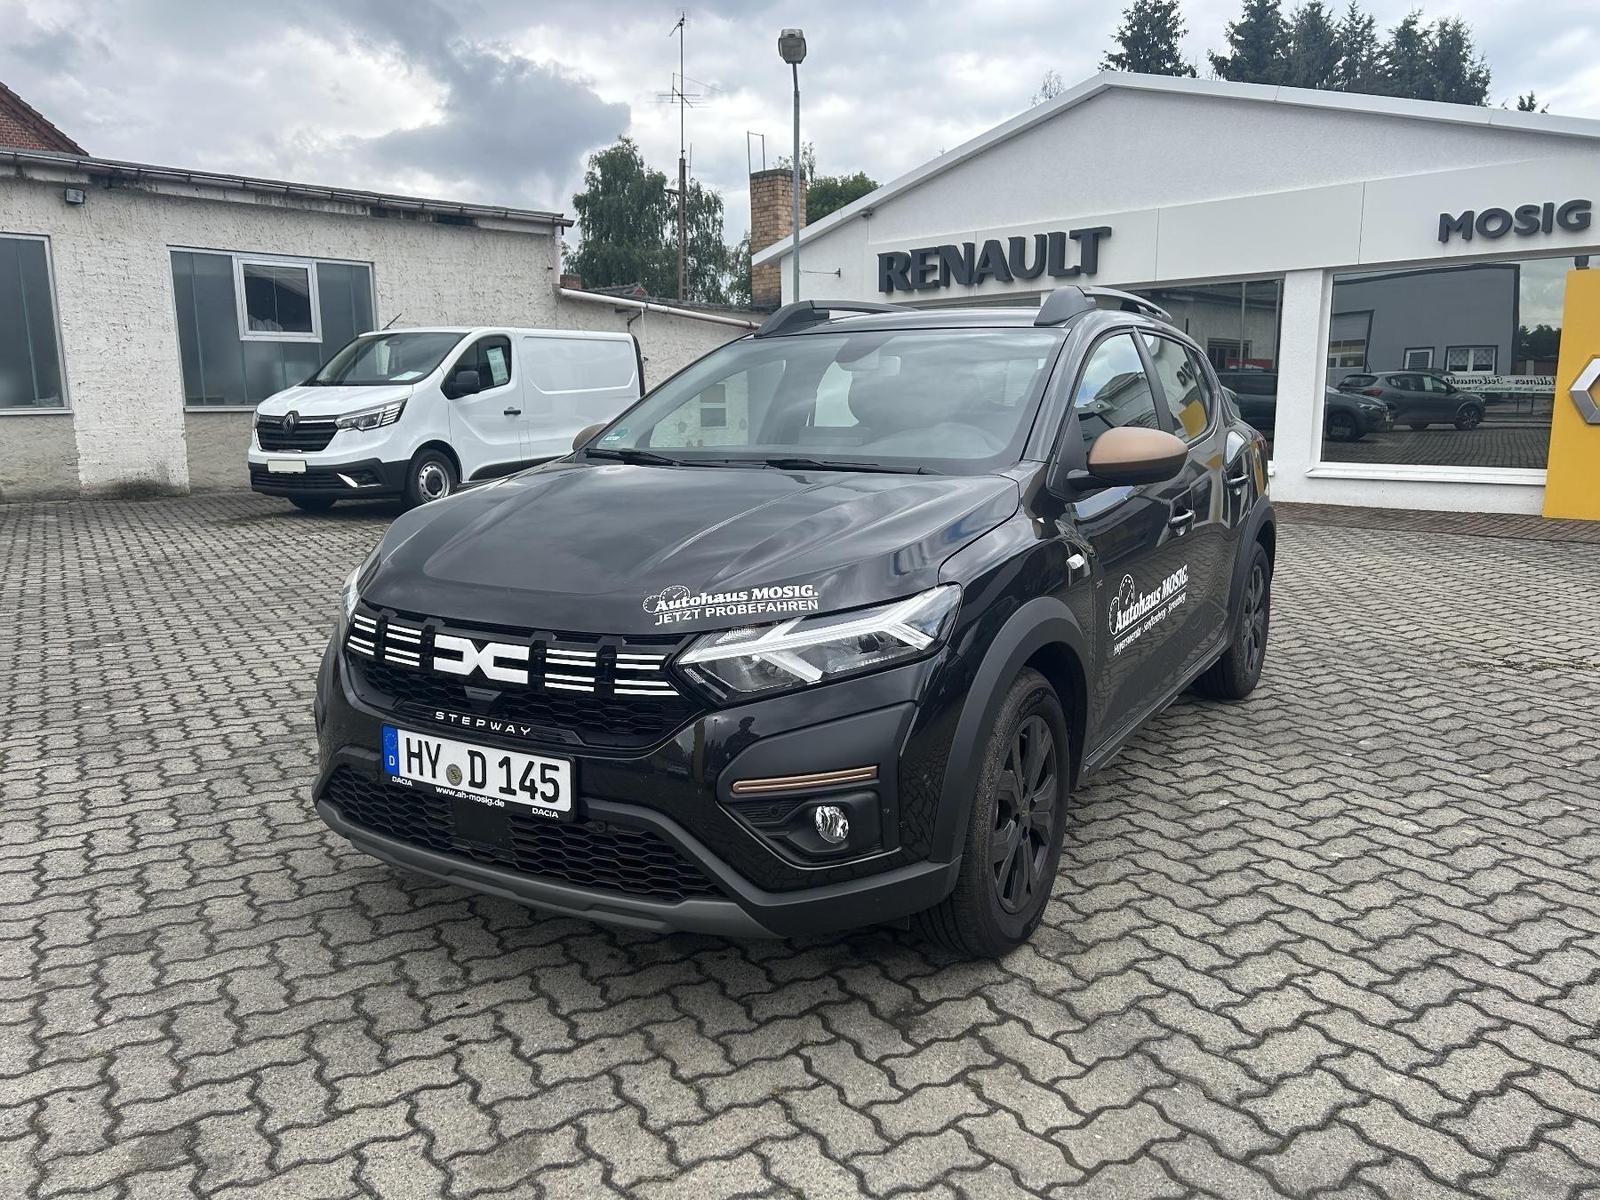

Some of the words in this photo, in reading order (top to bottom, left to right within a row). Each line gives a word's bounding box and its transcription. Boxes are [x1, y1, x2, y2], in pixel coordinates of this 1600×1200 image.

[1438, 199, 1592, 242] MOSIG
[877, 226, 1112, 293] RENAULT
[655, 591, 748, 612] Autohaus
[752, 584, 819, 599] MOSIG.
[1116, 586, 1162, 632] Autohaus
[654, 610, 701, 626] JETZT
[705, 600, 819, 617] PROBEFAHREN
[435, 711, 531, 736] STEPWAY
[388, 755, 396, 766] D
[405, 737, 442, 779] HY
[467, 749, 487, 789] D
[498, 756, 560, 803] 145
[391, 775, 413, 787] DACIA
[435, 786, 505, 807] www.ah-mosig.de
[531, 807, 559, 819] DACIA
